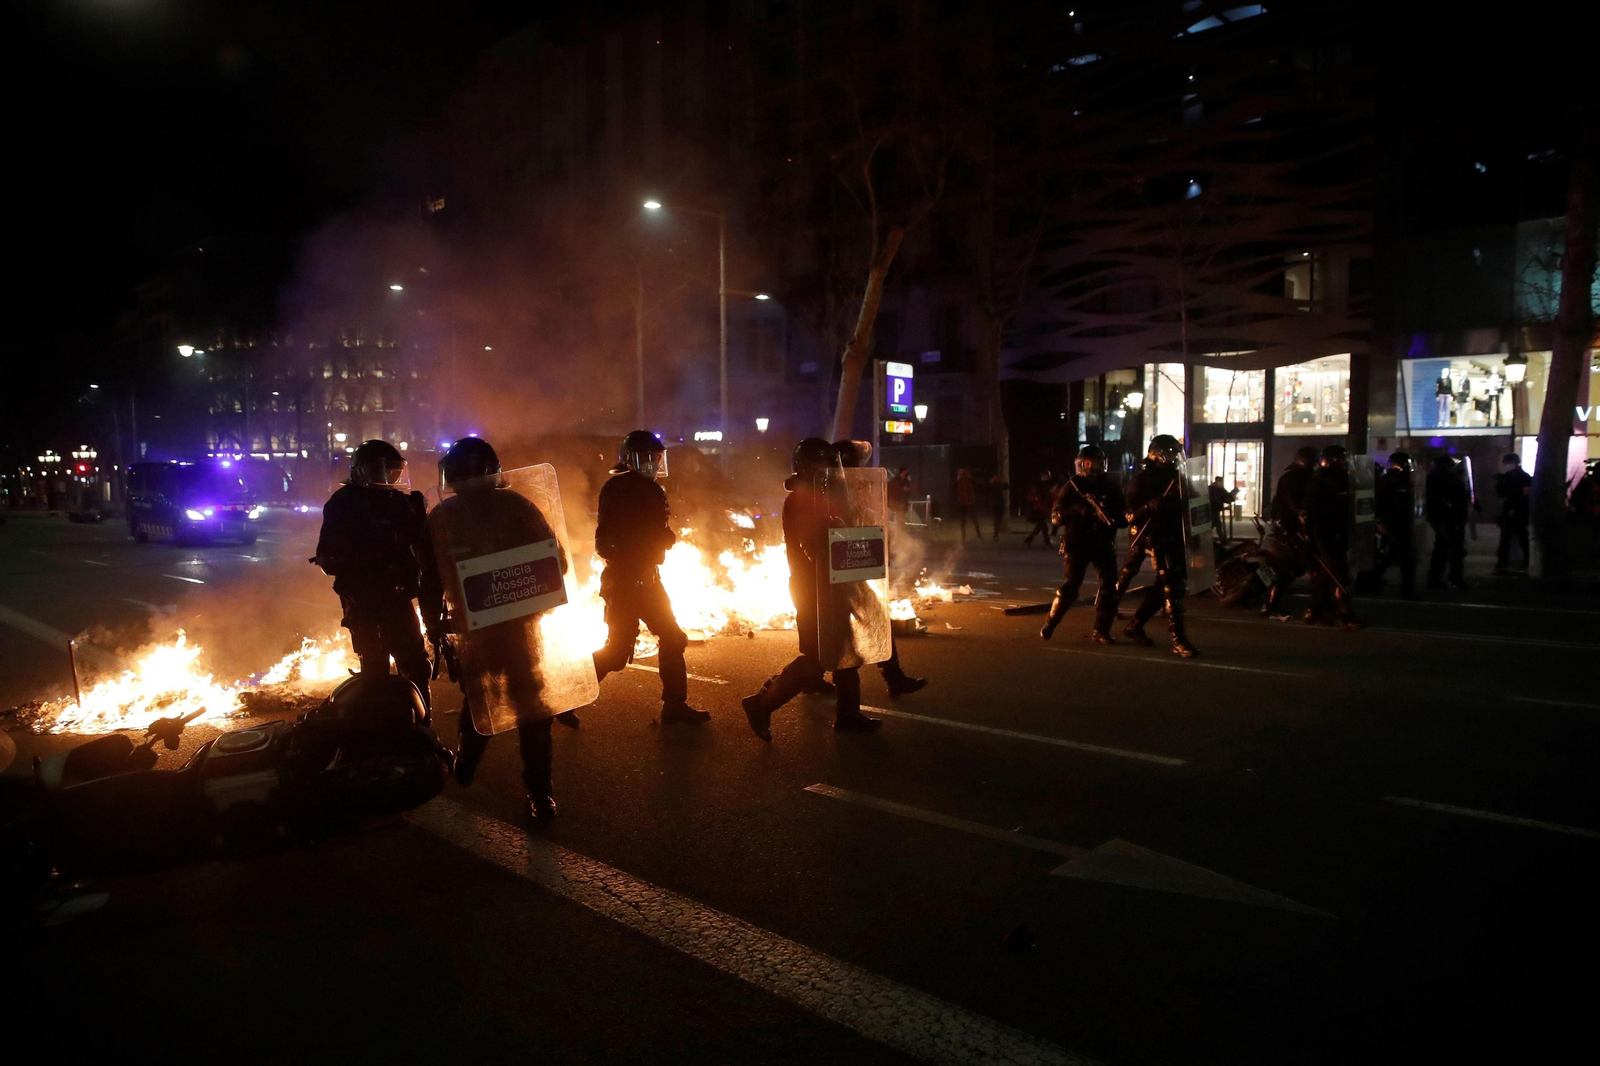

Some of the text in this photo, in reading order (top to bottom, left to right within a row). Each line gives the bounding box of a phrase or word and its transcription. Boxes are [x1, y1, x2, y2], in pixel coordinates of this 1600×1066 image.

[894, 378, 906, 403] P
[846, 549, 872, 558] Mossos
[492, 564, 532, 582] Policia
[491, 574, 537, 593] Mossos
[483, 582, 549, 607] d'Esquadra
